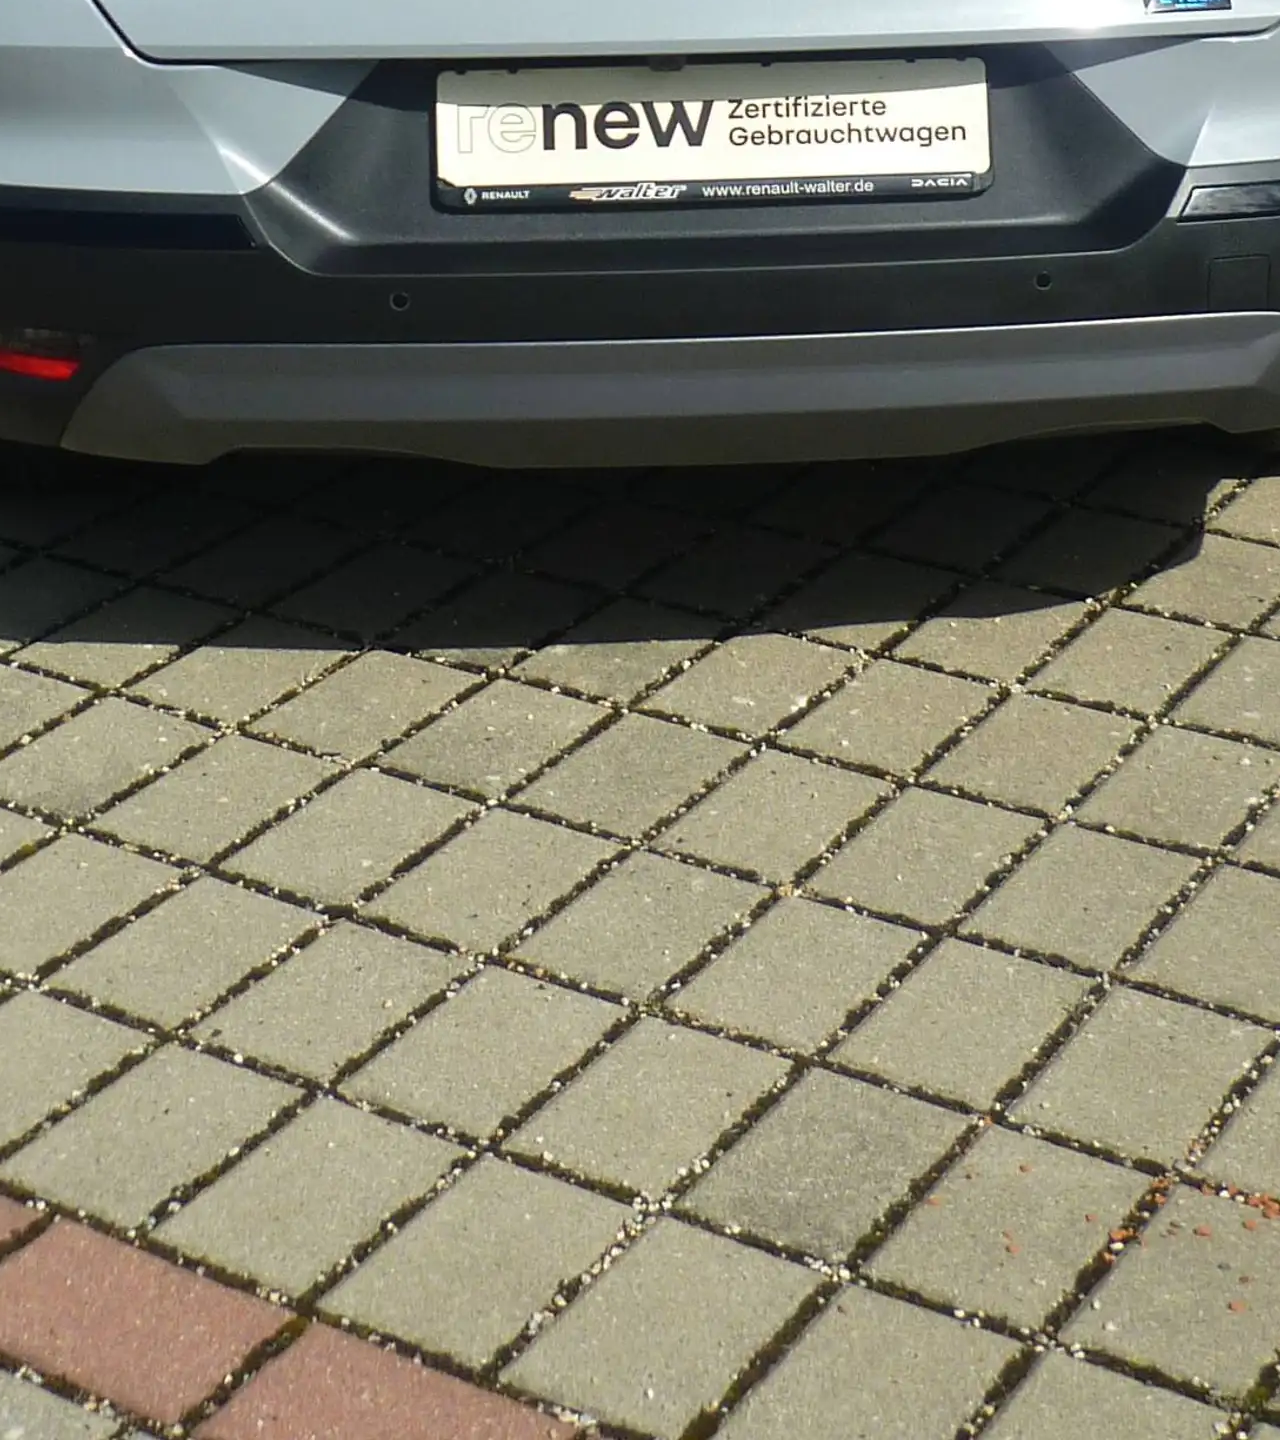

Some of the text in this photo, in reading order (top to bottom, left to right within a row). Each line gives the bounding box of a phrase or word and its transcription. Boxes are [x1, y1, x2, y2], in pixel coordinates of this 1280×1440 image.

[728, 95, 887, 119] Zertifizierte
[457, 100, 713, 154] renew
[729, 123, 967, 147] Gebrauchtwagen
[596, 182, 688, 203] walter
[701, 178, 875, 198] www.renault-walter.de
[911, 176, 969, 188] DACIA
[481, 190, 531, 200] RENAULT
